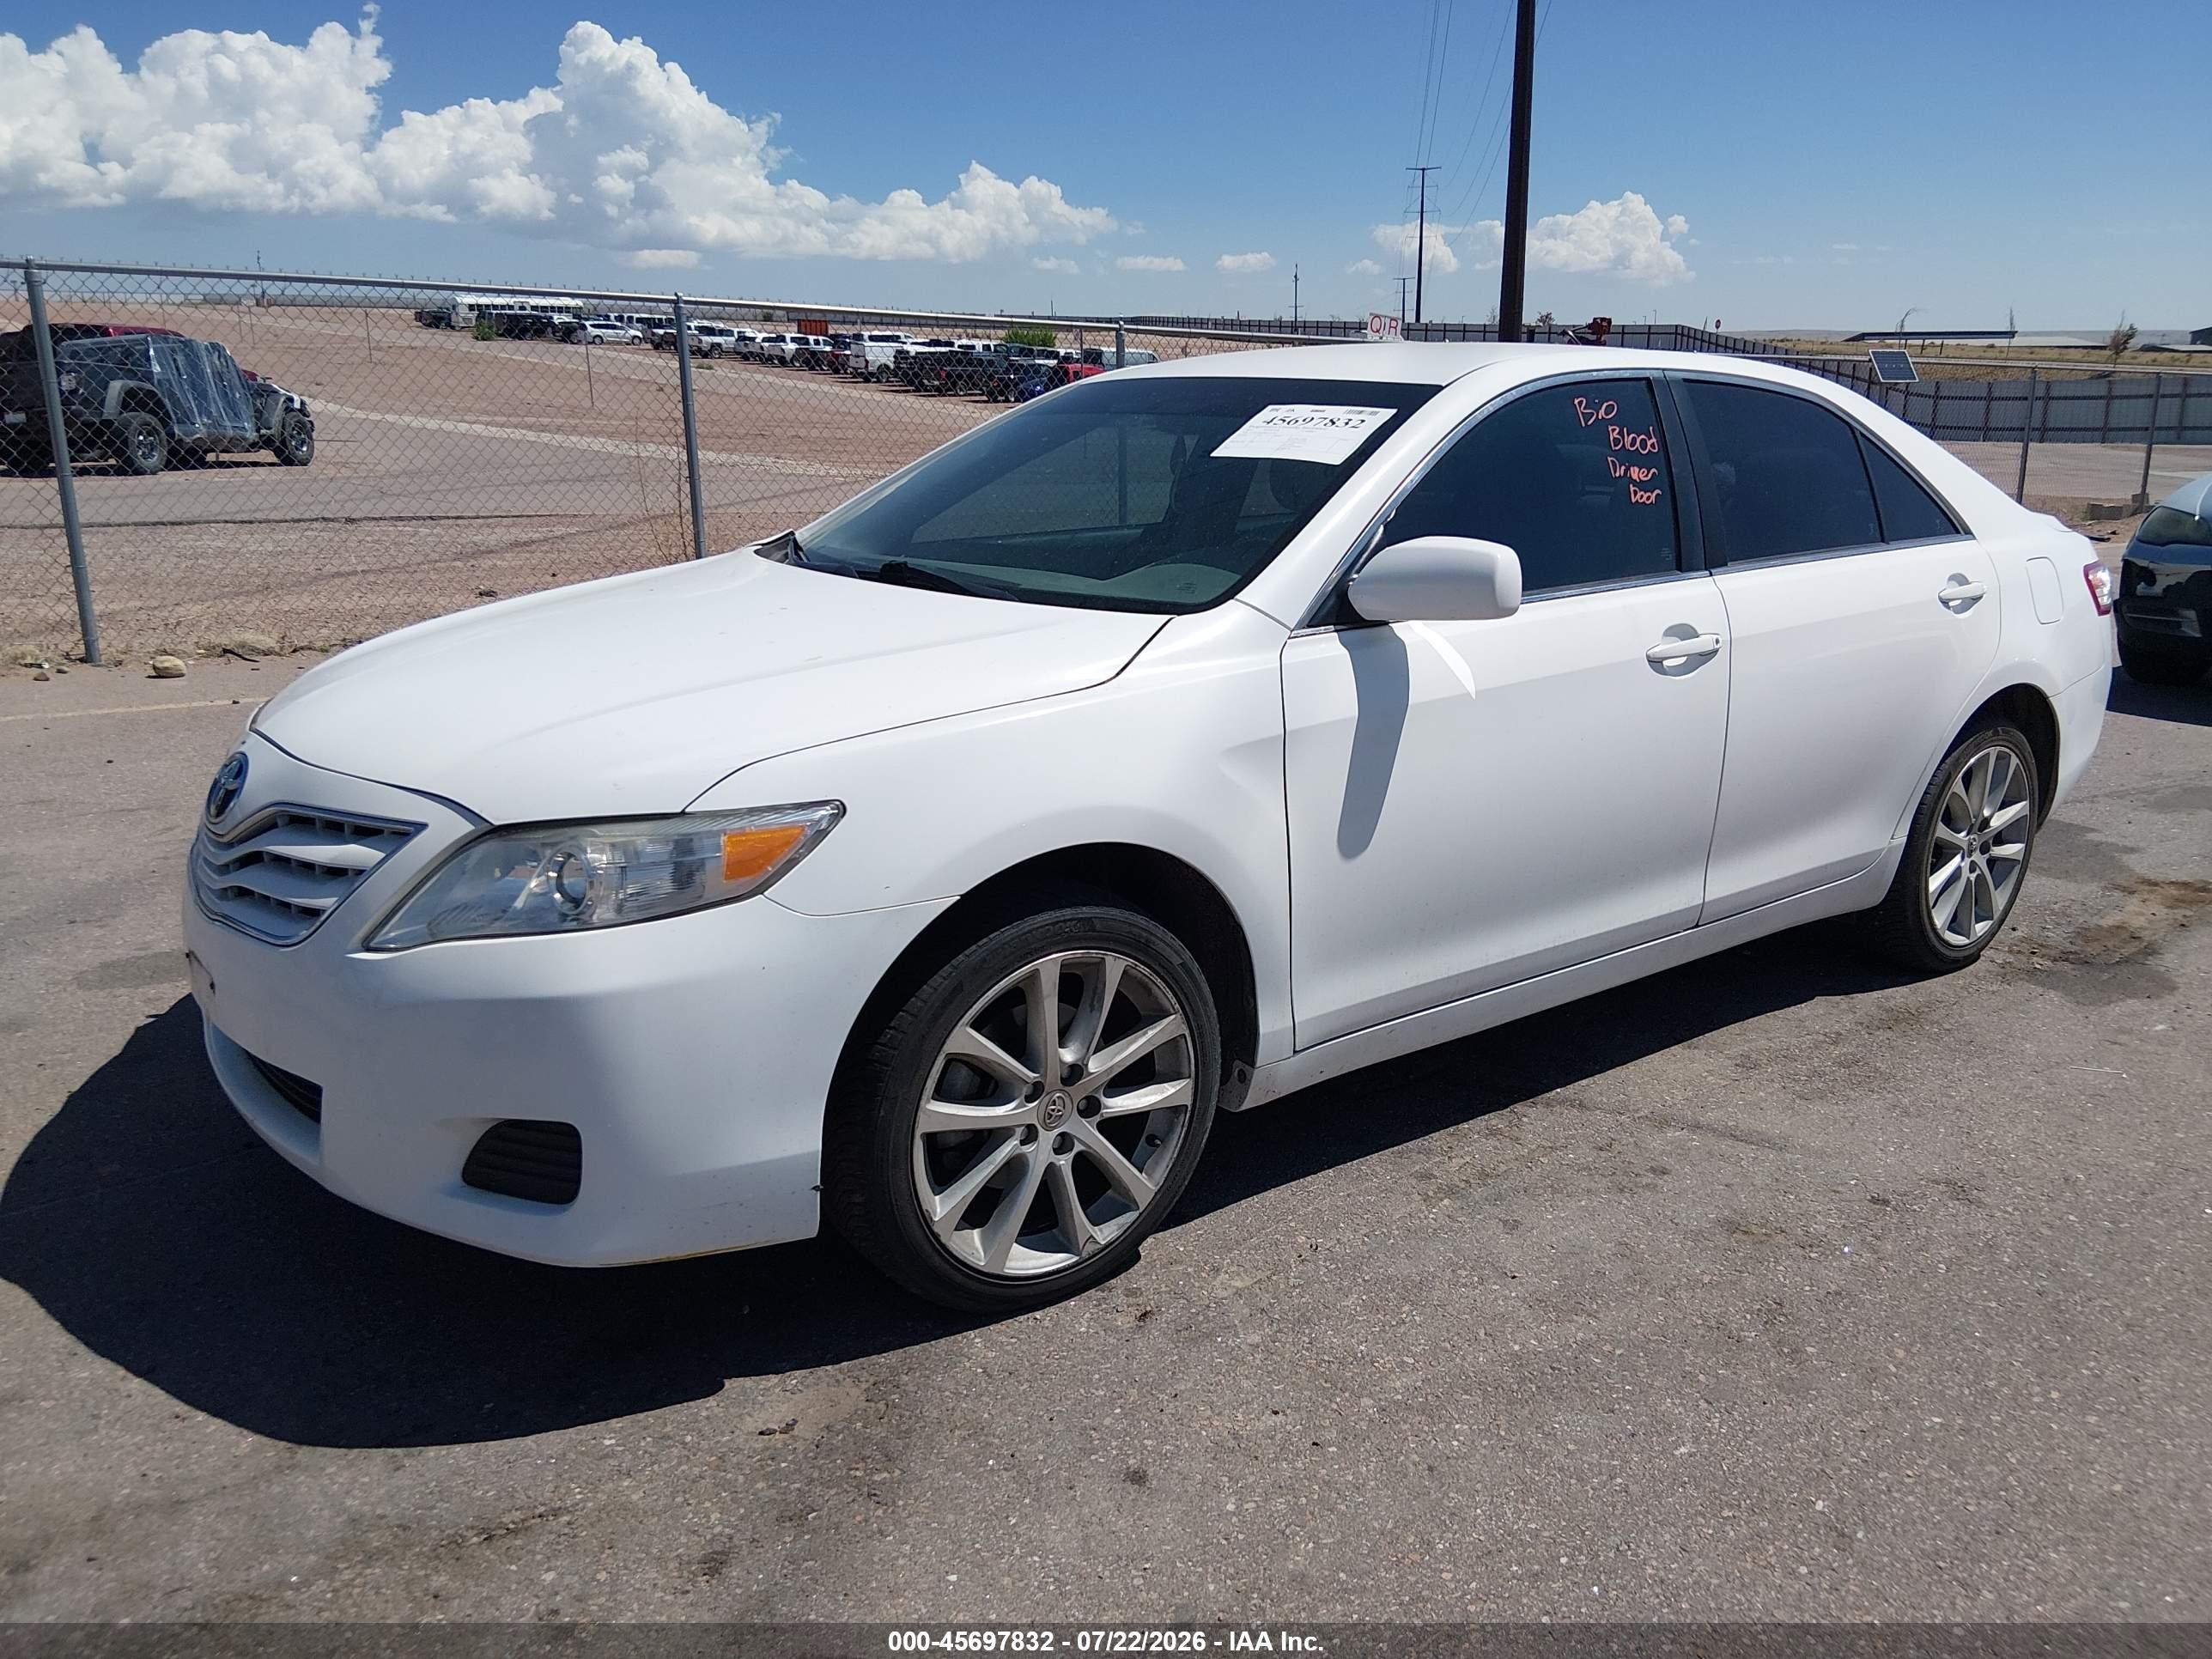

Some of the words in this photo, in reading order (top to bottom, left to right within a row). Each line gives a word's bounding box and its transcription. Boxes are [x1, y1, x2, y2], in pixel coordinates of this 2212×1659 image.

[1262, 416, 1367, 428] 45697832
[1573, 397, 1618, 427] Bio
[1607, 425, 1659, 454] Blood
[1629, 483, 1662, 504] Door
